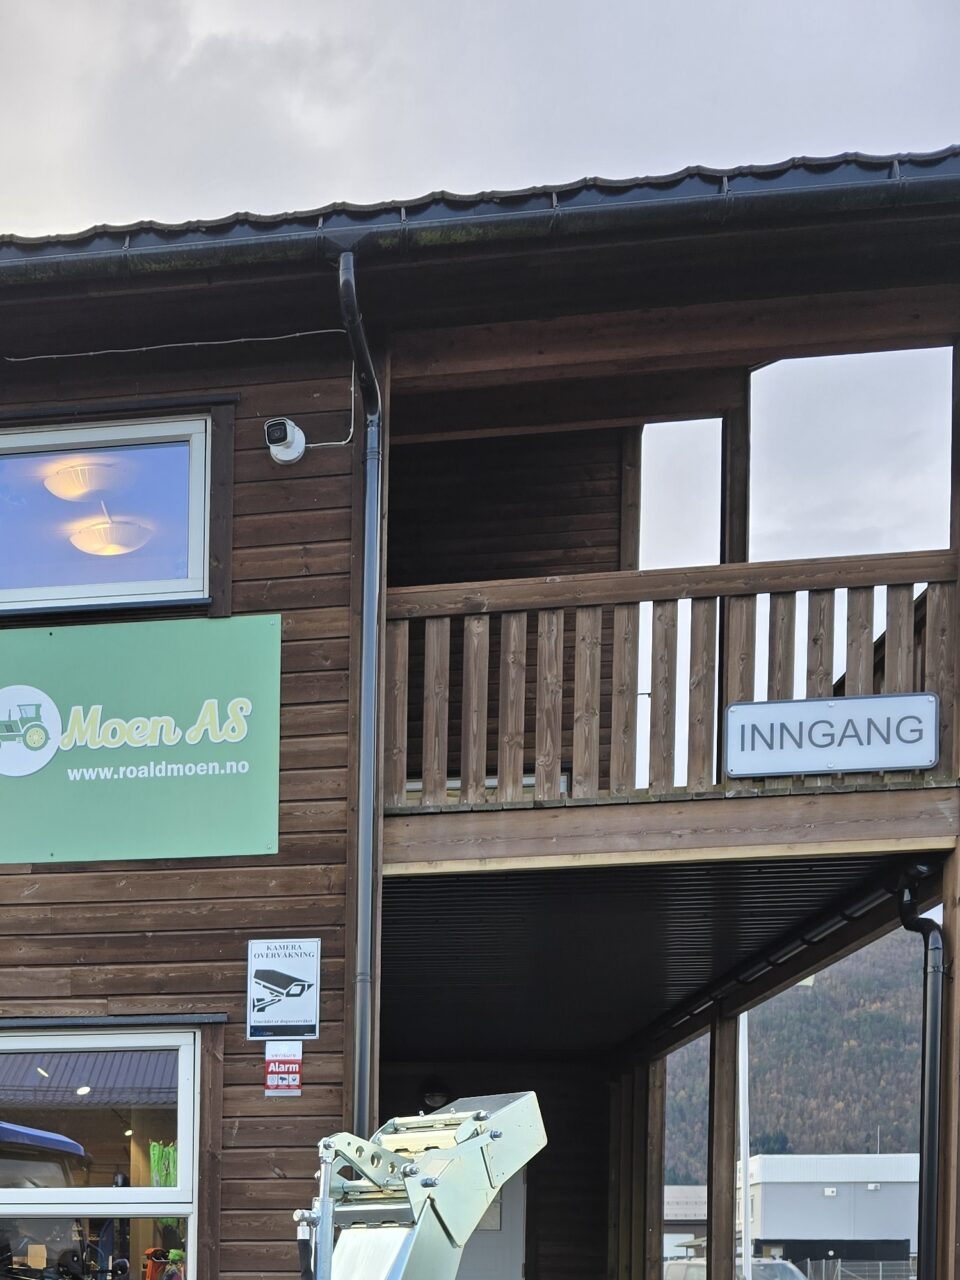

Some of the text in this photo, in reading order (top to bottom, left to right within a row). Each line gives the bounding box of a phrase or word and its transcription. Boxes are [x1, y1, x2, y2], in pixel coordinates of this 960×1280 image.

[59, 704, 183, 751] Moen
[185, 697, 252, 745] AS
[740, 715, 924, 752] INNGANG
[67, 760, 250, 781] www.roaldmoen.no
[268, 1062, 299, 1072] Alarm
